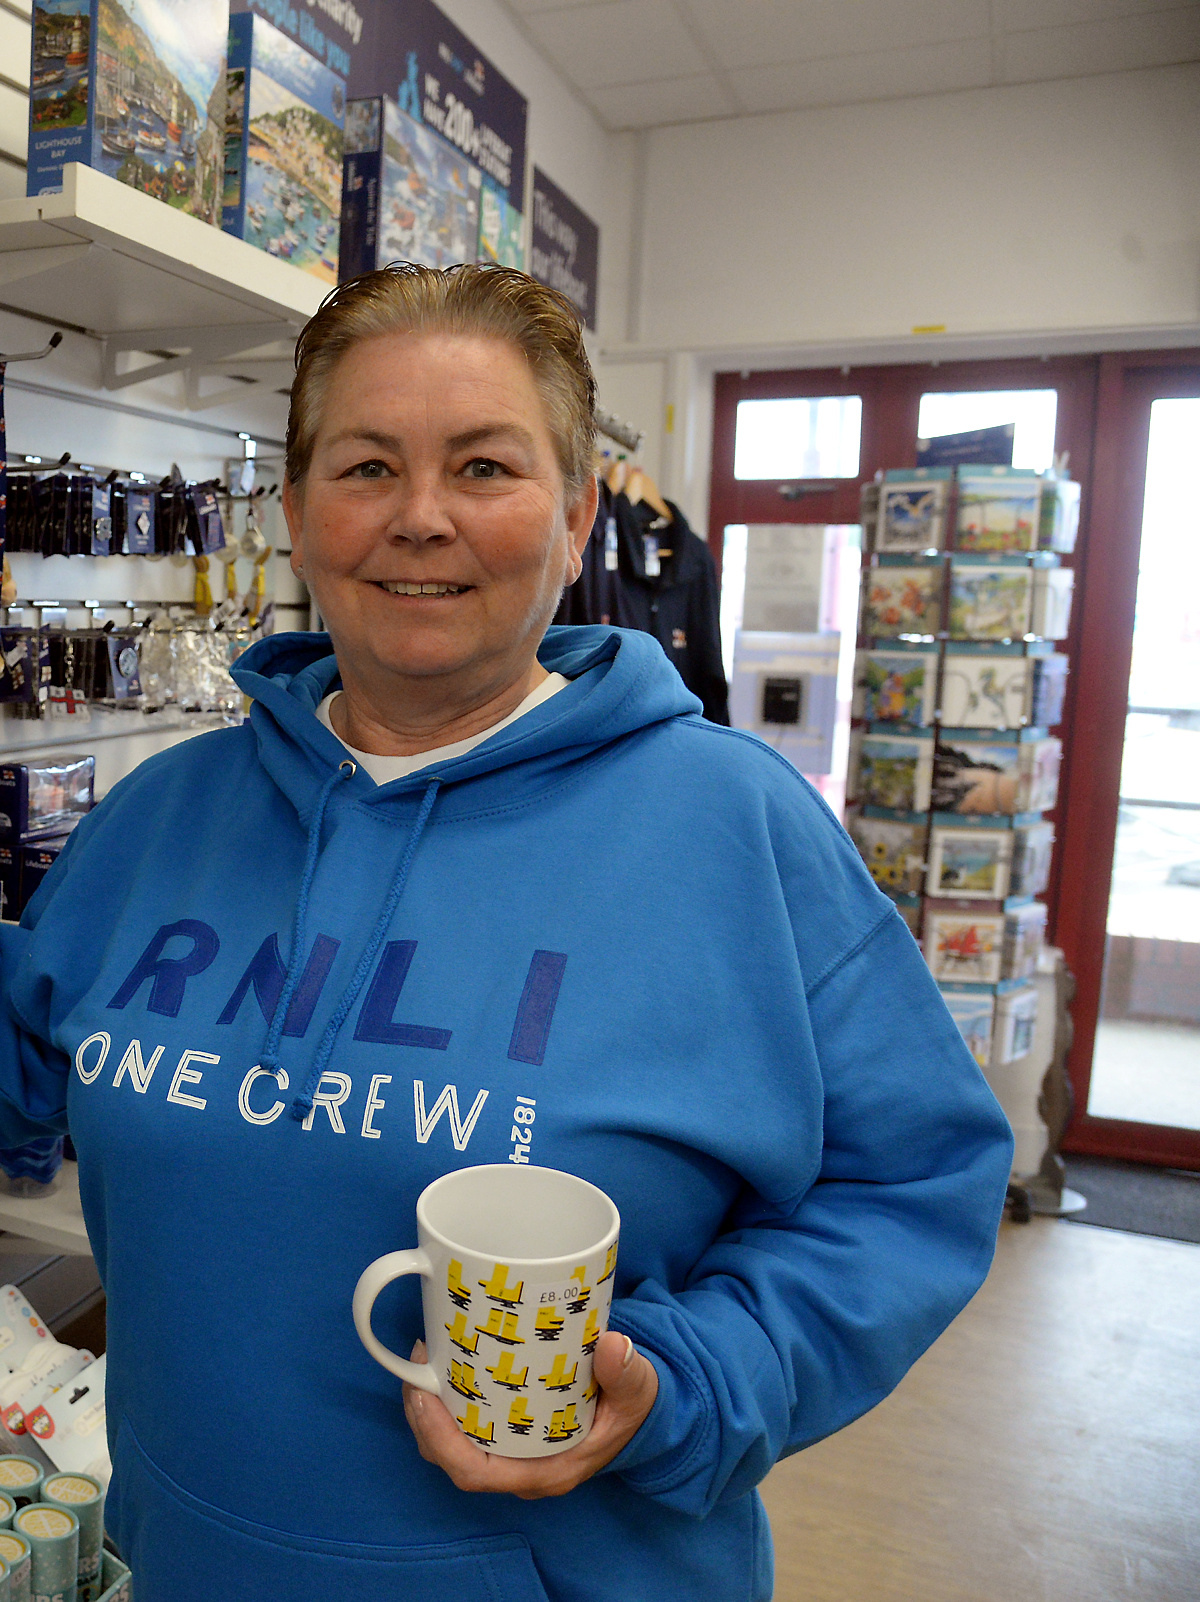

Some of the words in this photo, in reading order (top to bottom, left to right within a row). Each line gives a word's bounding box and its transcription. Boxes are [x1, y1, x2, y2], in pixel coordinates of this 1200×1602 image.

[35, 136, 82, 150] LIGHTHOUSE
[105, 918, 568, 1066] RNLI
[75, 1030, 221, 1110] ONE
[237, 1064, 490, 1152] CREW
[508, 1095, 536, 1164] 1824
[539, 1286, 579, 1304] £8.00
